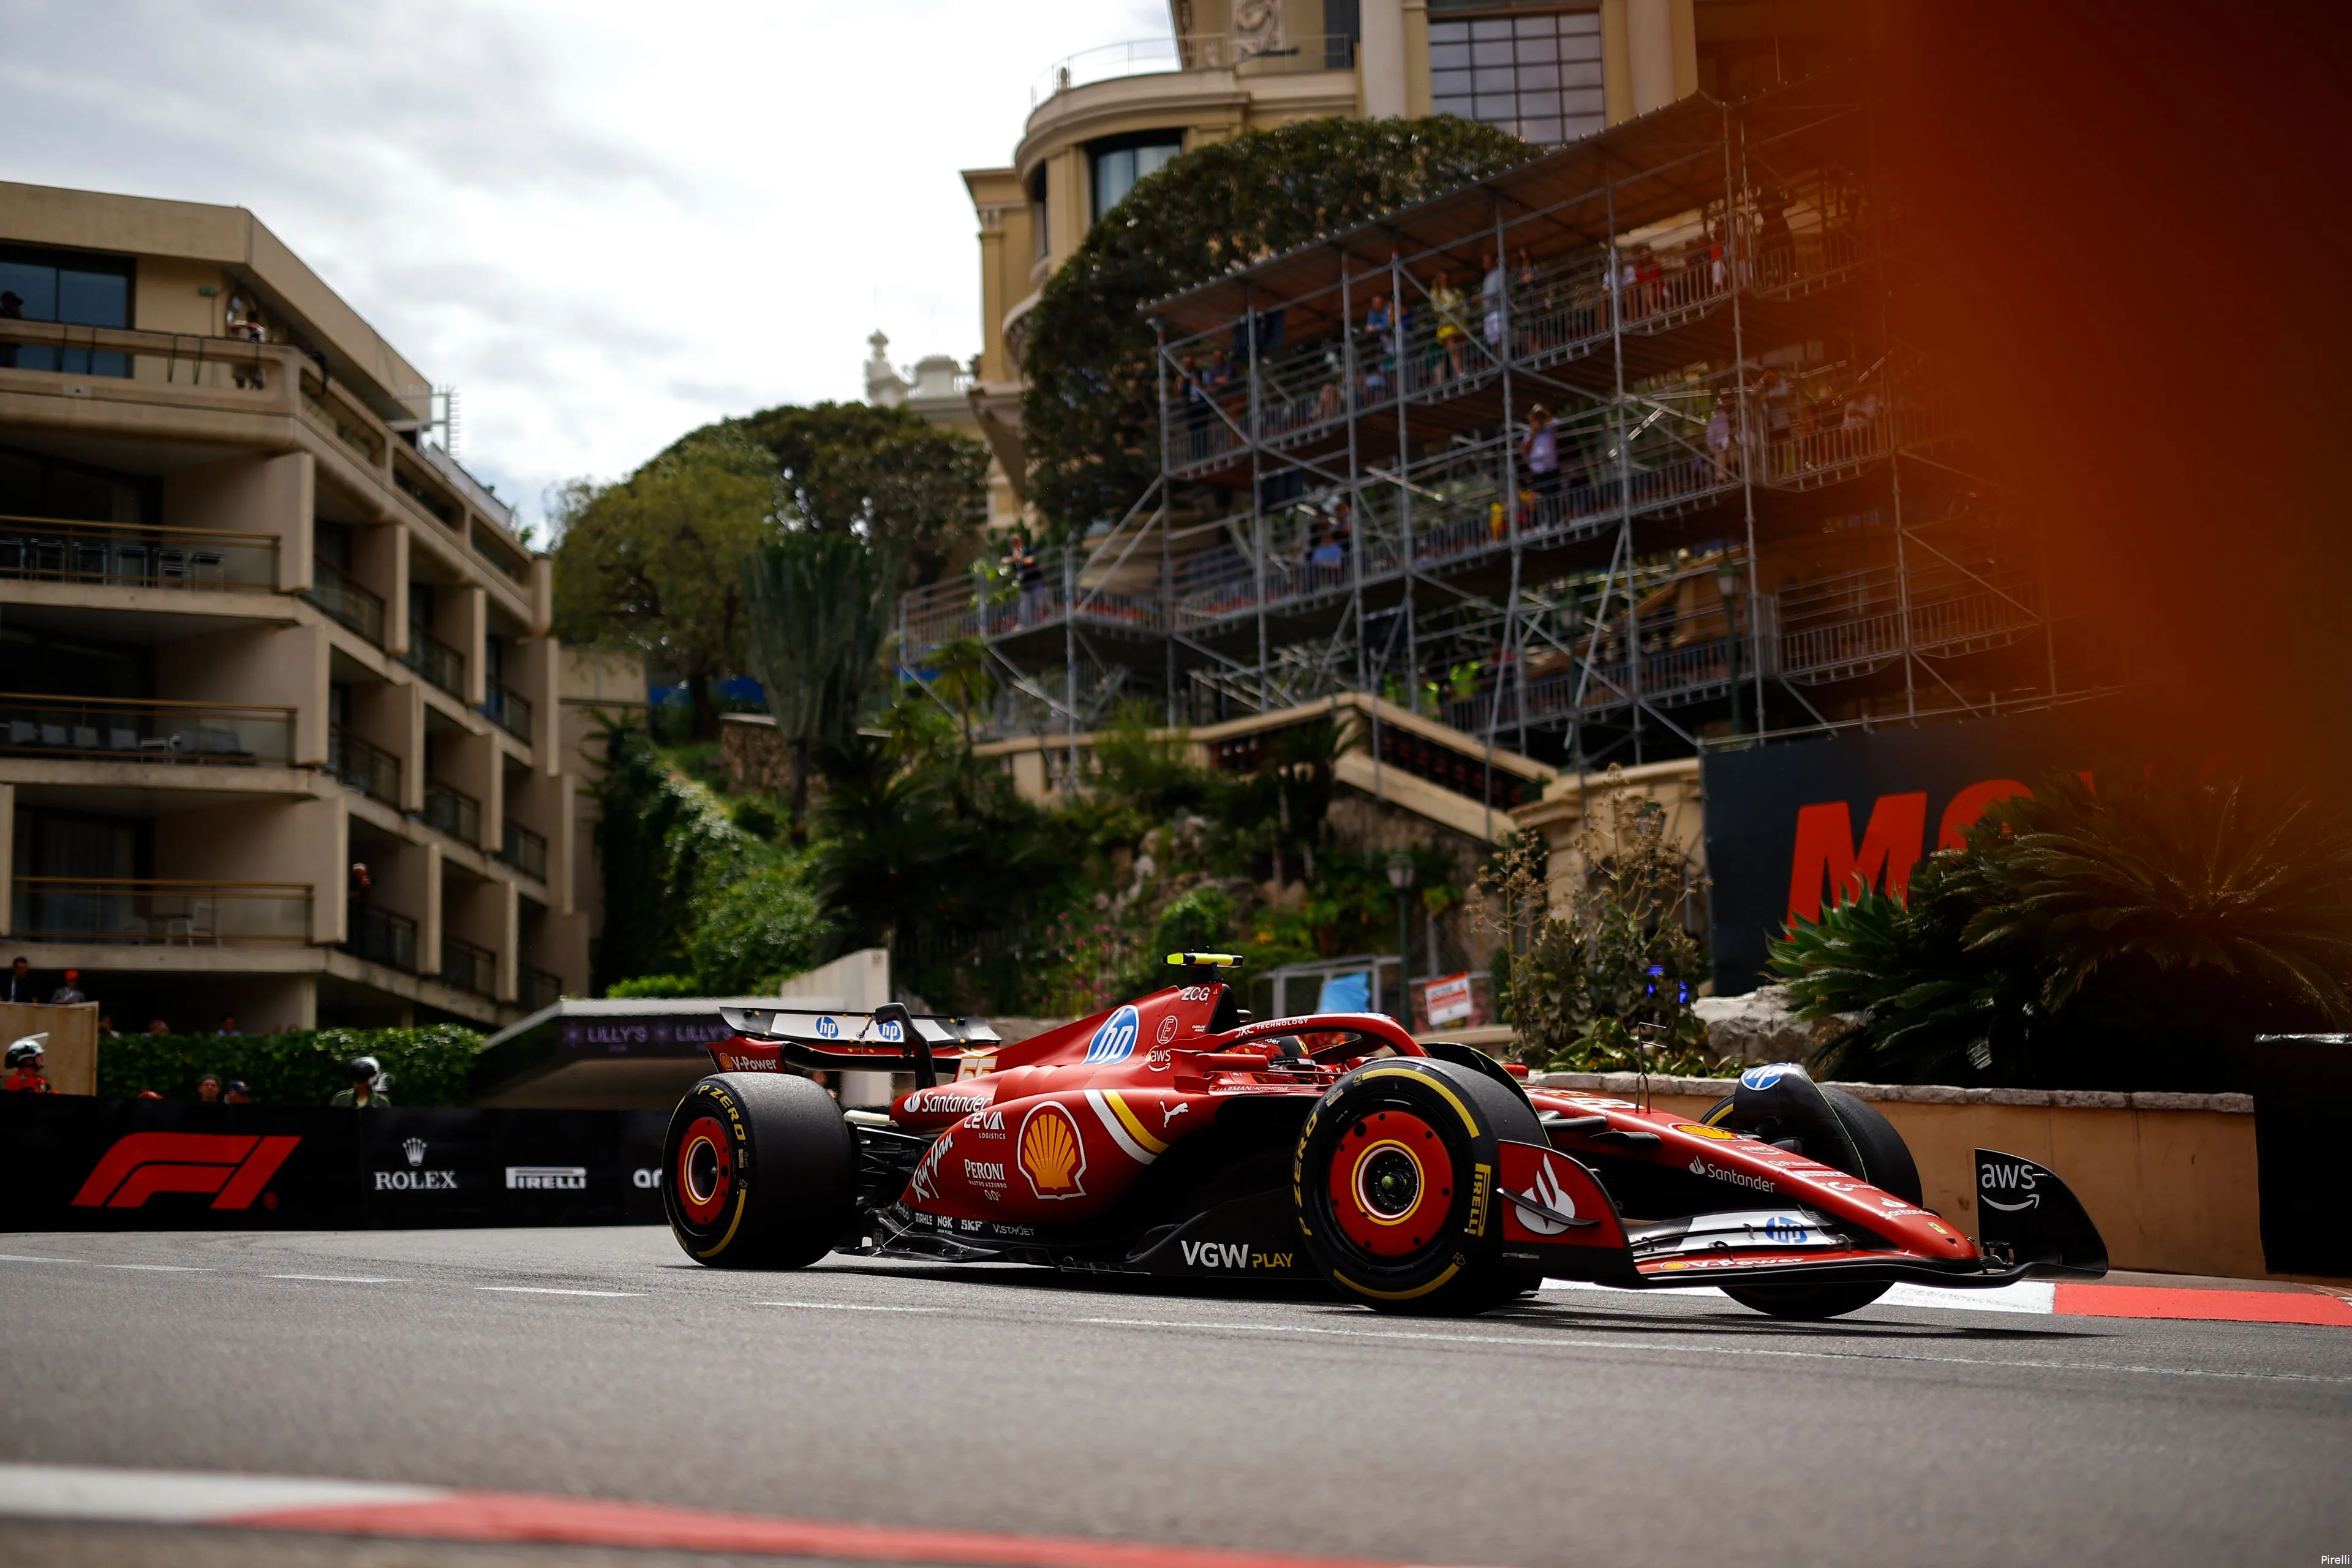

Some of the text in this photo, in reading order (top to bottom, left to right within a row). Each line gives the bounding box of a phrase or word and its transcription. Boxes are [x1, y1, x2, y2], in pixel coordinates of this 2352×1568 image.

[1182, 986, 1210, 1001] ZCG
[587, 1025, 647, 1042] LILLY'S
[818, 1017, 837, 1038] hp
[881, 1021, 899, 1041] hp
[1256, 1019, 1308, 1030] TECHNOLOGY
[1088, 1007, 1134, 1065] hp
[731, 1057, 777, 1071] V-Power
[1151, 1049, 1170, 1062] aws
[698, 1085, 746, 1140] P ZERO
[921, 1091, 993, 1113] Santander
[69, 1131, 303, 1210] F1
[374, 1170, 458, 1191] ROLEX
[505, 1166, 587, 1189] PIRELLI
[964, 1159, 1006, 1181] PERONI
[1293, 1112, 1317, 1236] P ZERO
[1707, 1163, 1776, 1193] Santander
[1981, 1164, 2036, 1189] aws
[1468, 1163, 1491, 1237] PIRELLI
[915, 1212, 932, 1225] MAHLE
[937, 1216, 953, 1229] NGK
[961, 1219, 982, 1231] SKF
[1771, 1216, 1803, 1244] hp
[1180, 1240, 1294, 1268] VGW PLAY
[1689, 1257, 1804, 1268] V-Power
